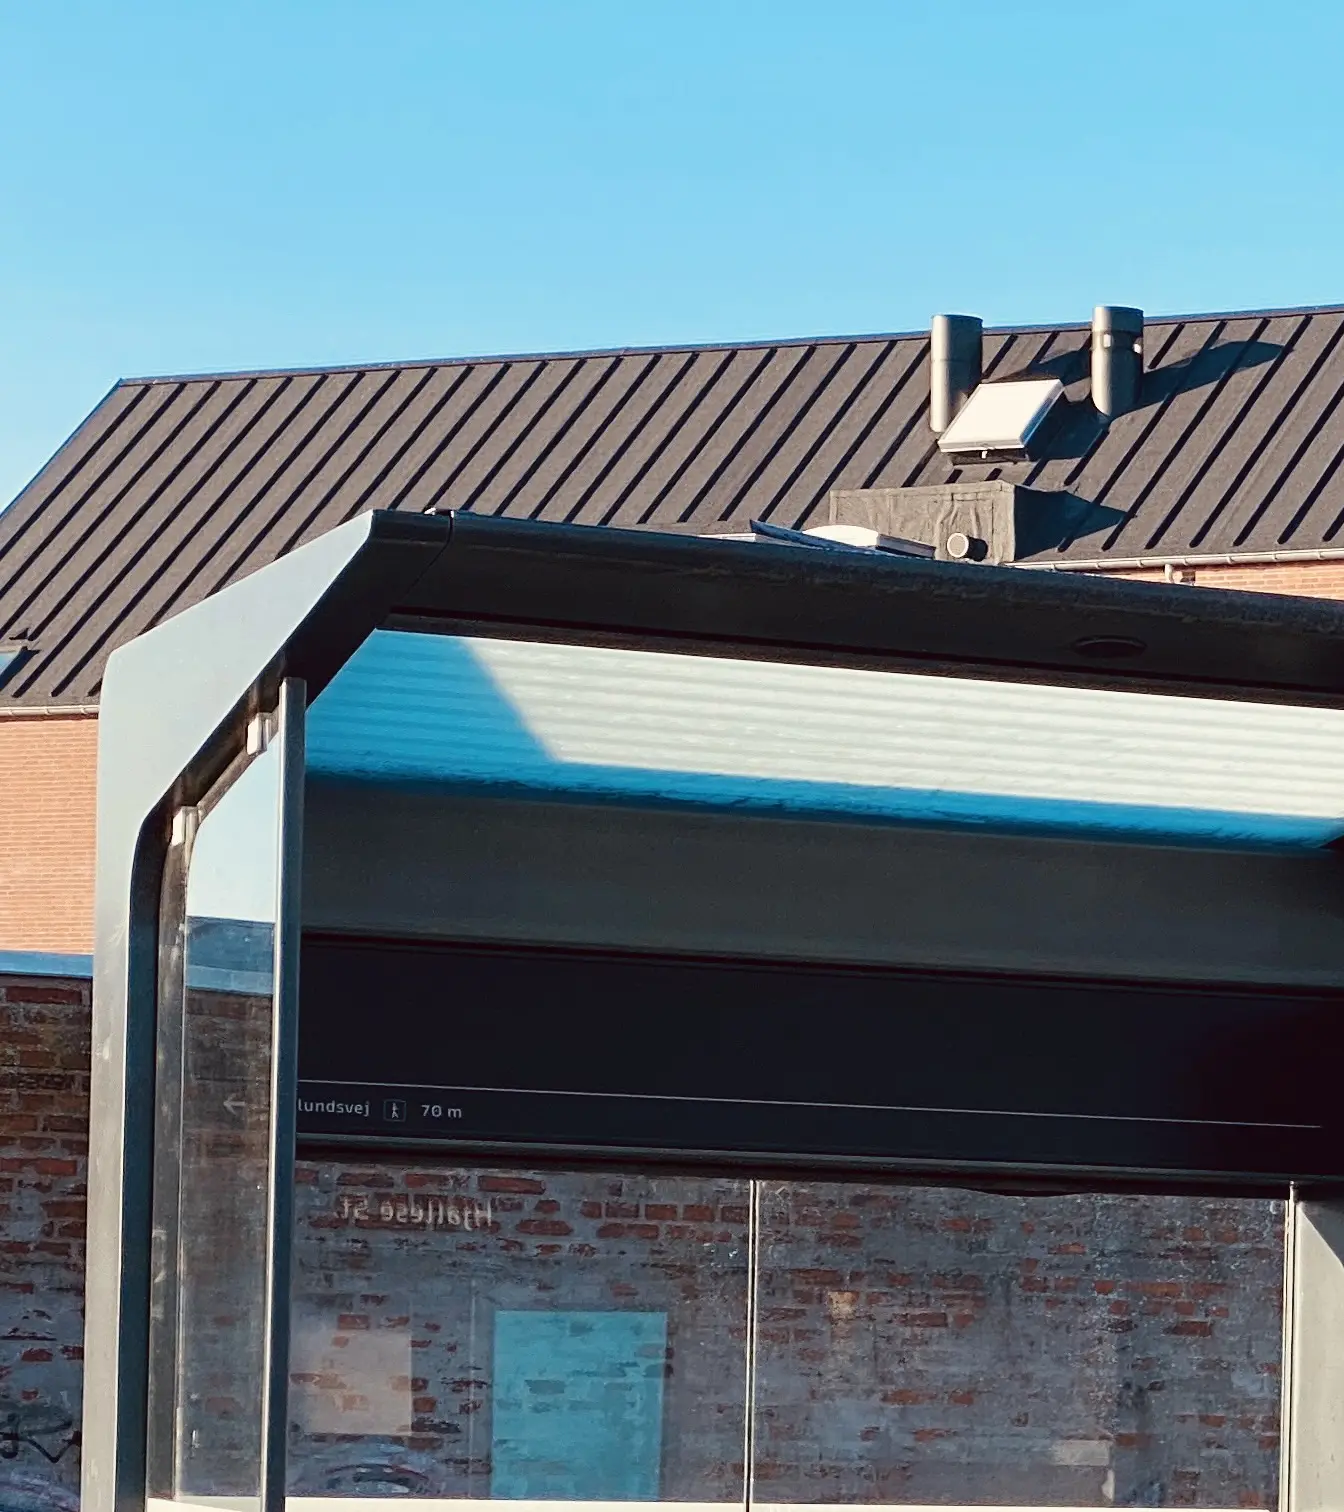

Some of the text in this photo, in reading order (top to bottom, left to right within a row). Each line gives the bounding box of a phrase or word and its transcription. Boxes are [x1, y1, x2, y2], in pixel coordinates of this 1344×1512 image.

[297, 1098, 463, 1119] lundsvej 70 m
